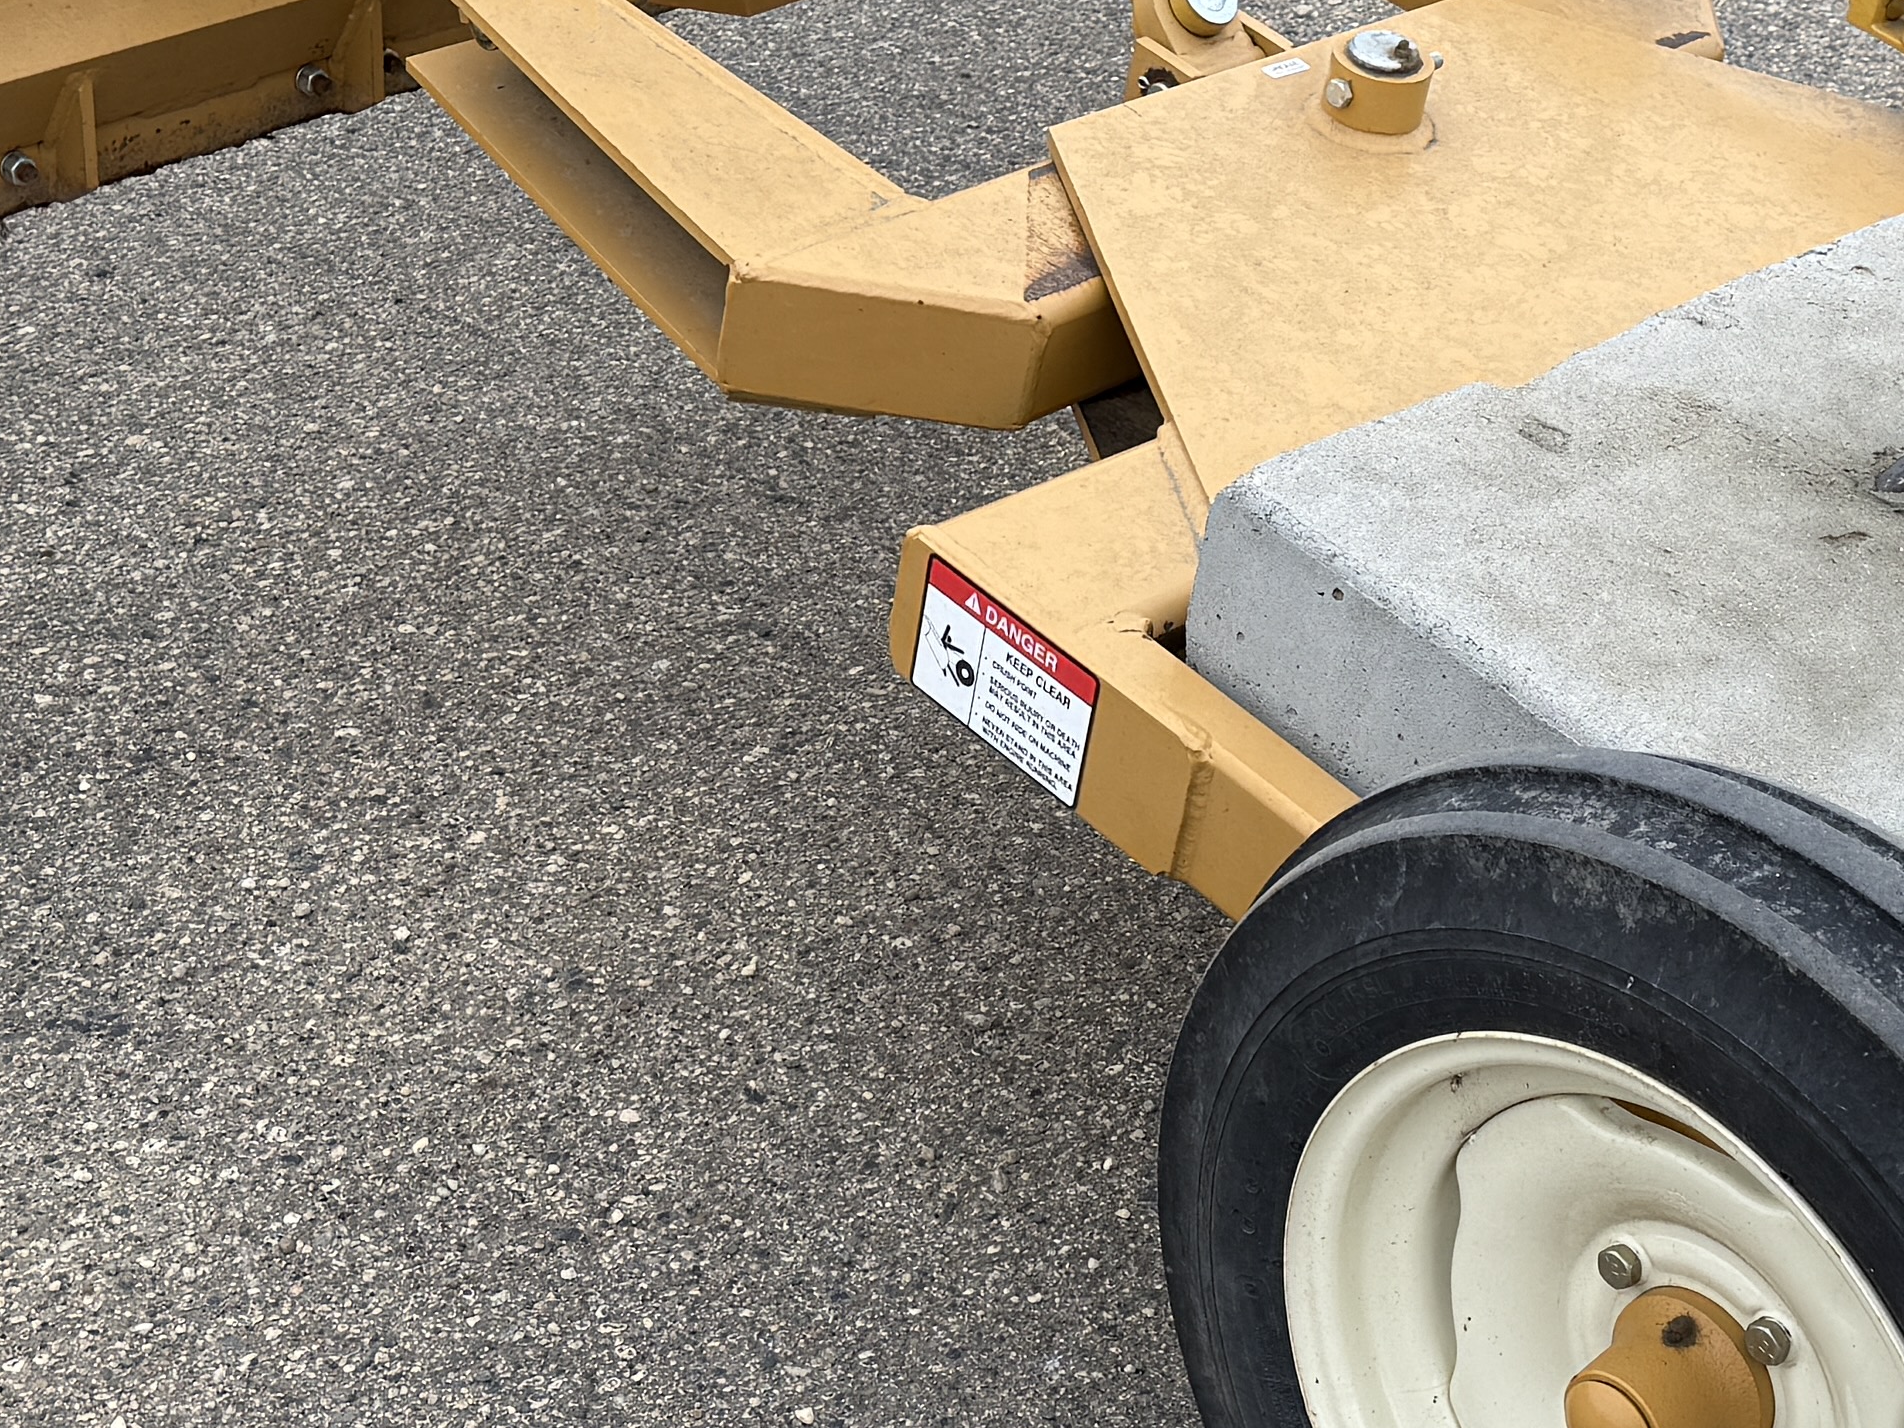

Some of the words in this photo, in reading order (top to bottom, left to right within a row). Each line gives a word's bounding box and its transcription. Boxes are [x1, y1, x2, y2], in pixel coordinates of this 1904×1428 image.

[985, 605, 1058, 673] DANGER
[1006, 652, 1034, 678] KEEP
[1036, 675, 1071, 710] CLEAR
